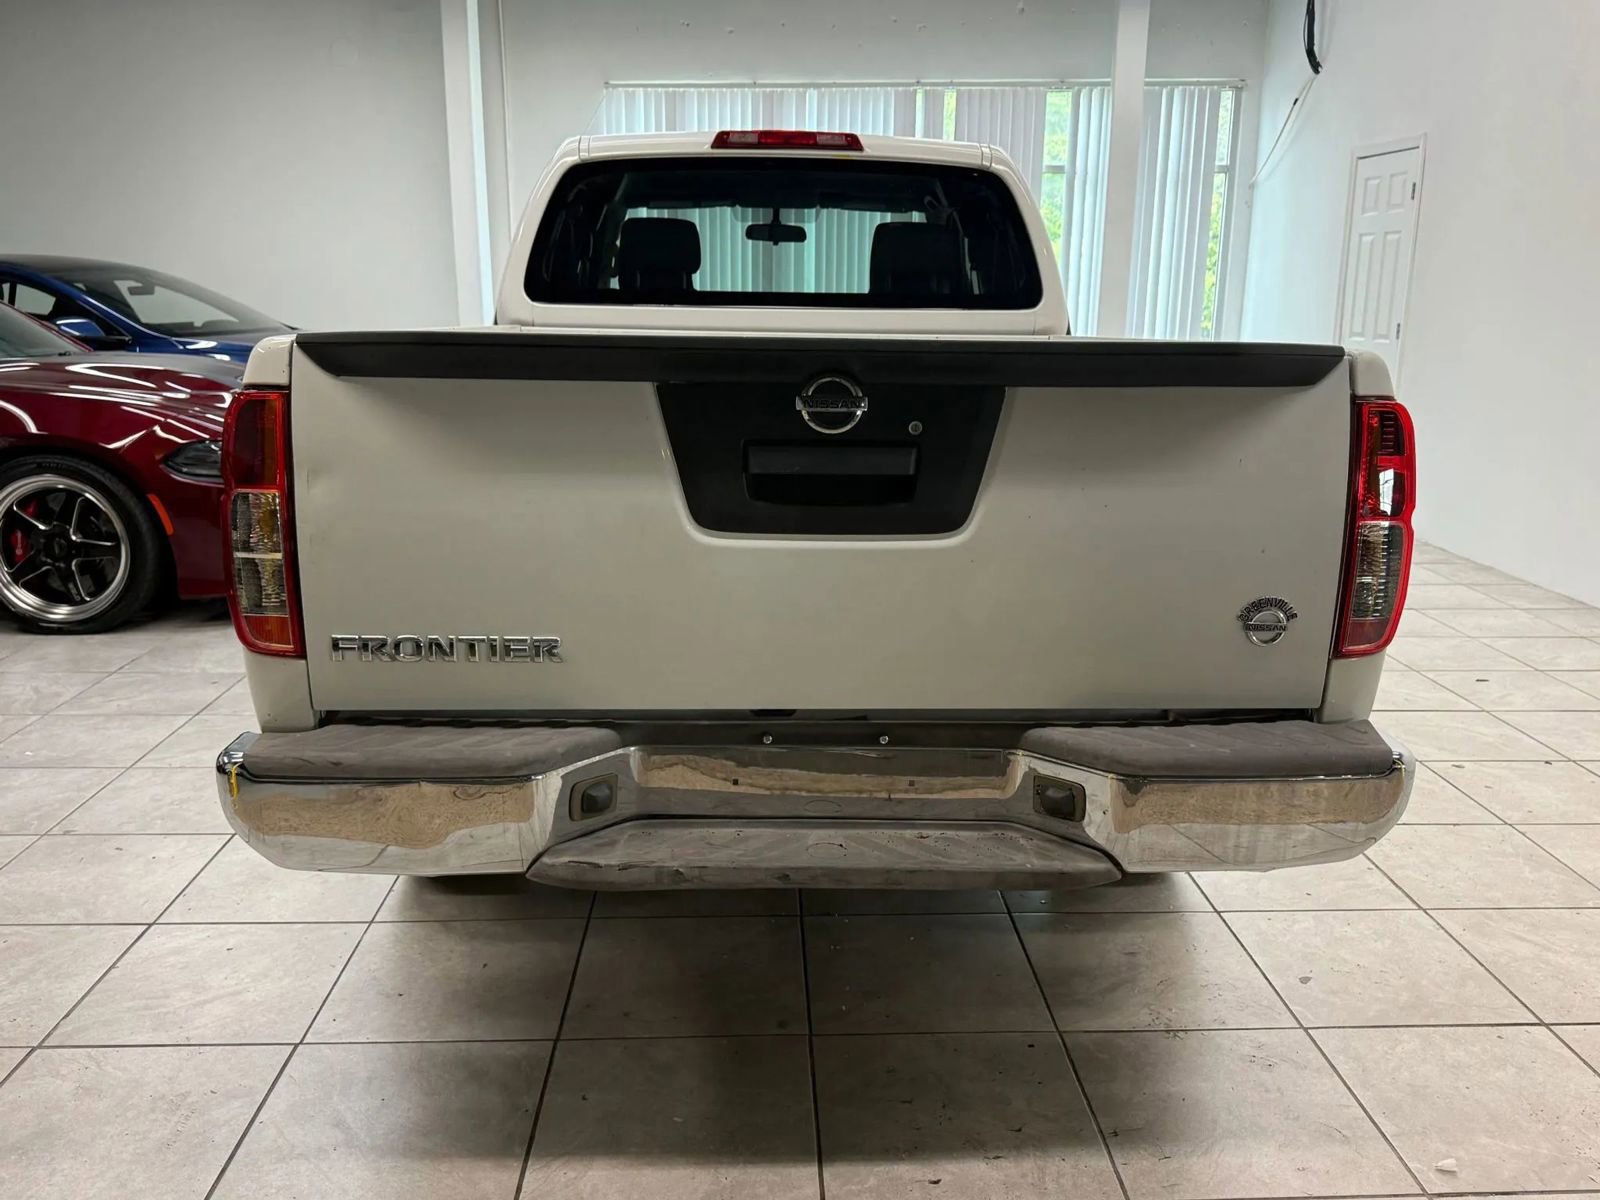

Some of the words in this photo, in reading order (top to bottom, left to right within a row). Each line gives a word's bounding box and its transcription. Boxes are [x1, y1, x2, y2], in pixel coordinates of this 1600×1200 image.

[804, 399, 861, 409] NISSAN
[1238, 597, 1298, 622] GREENVILLE
[1247, 623, 1287, 632] NISSAN
[330, 634, 563, 663] FRONTIER
